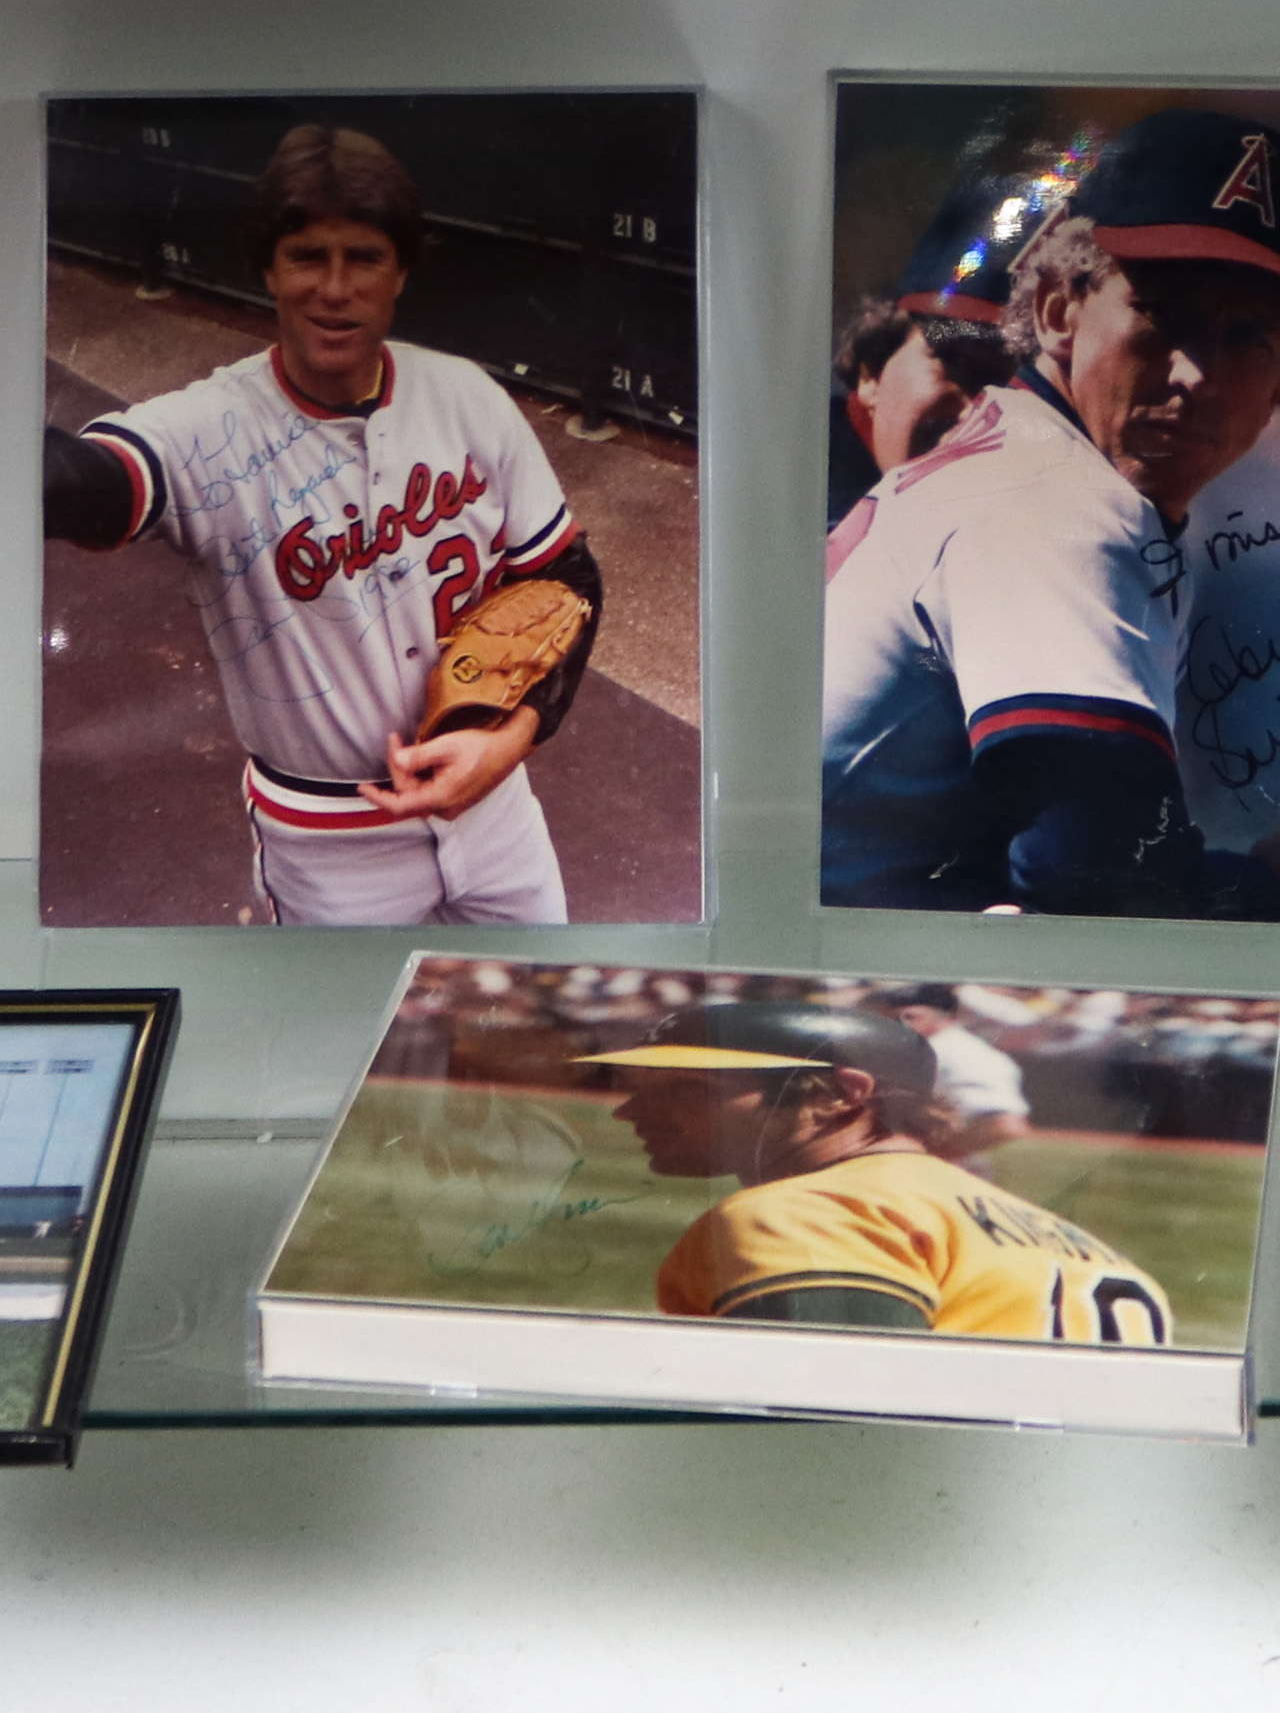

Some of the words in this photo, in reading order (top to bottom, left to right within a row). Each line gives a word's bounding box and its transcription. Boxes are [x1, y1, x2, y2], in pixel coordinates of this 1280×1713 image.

[1211, 132, 1276, 228] A
[613, 212, 633, 238] 21
[643, 215, 658, 243] B
[611, 366, 632, 392] 21
[640, 374, 655, 398] A
[275, 452, 488, 603] Orioles
[1050, 1264, 1167, 1345] 10
